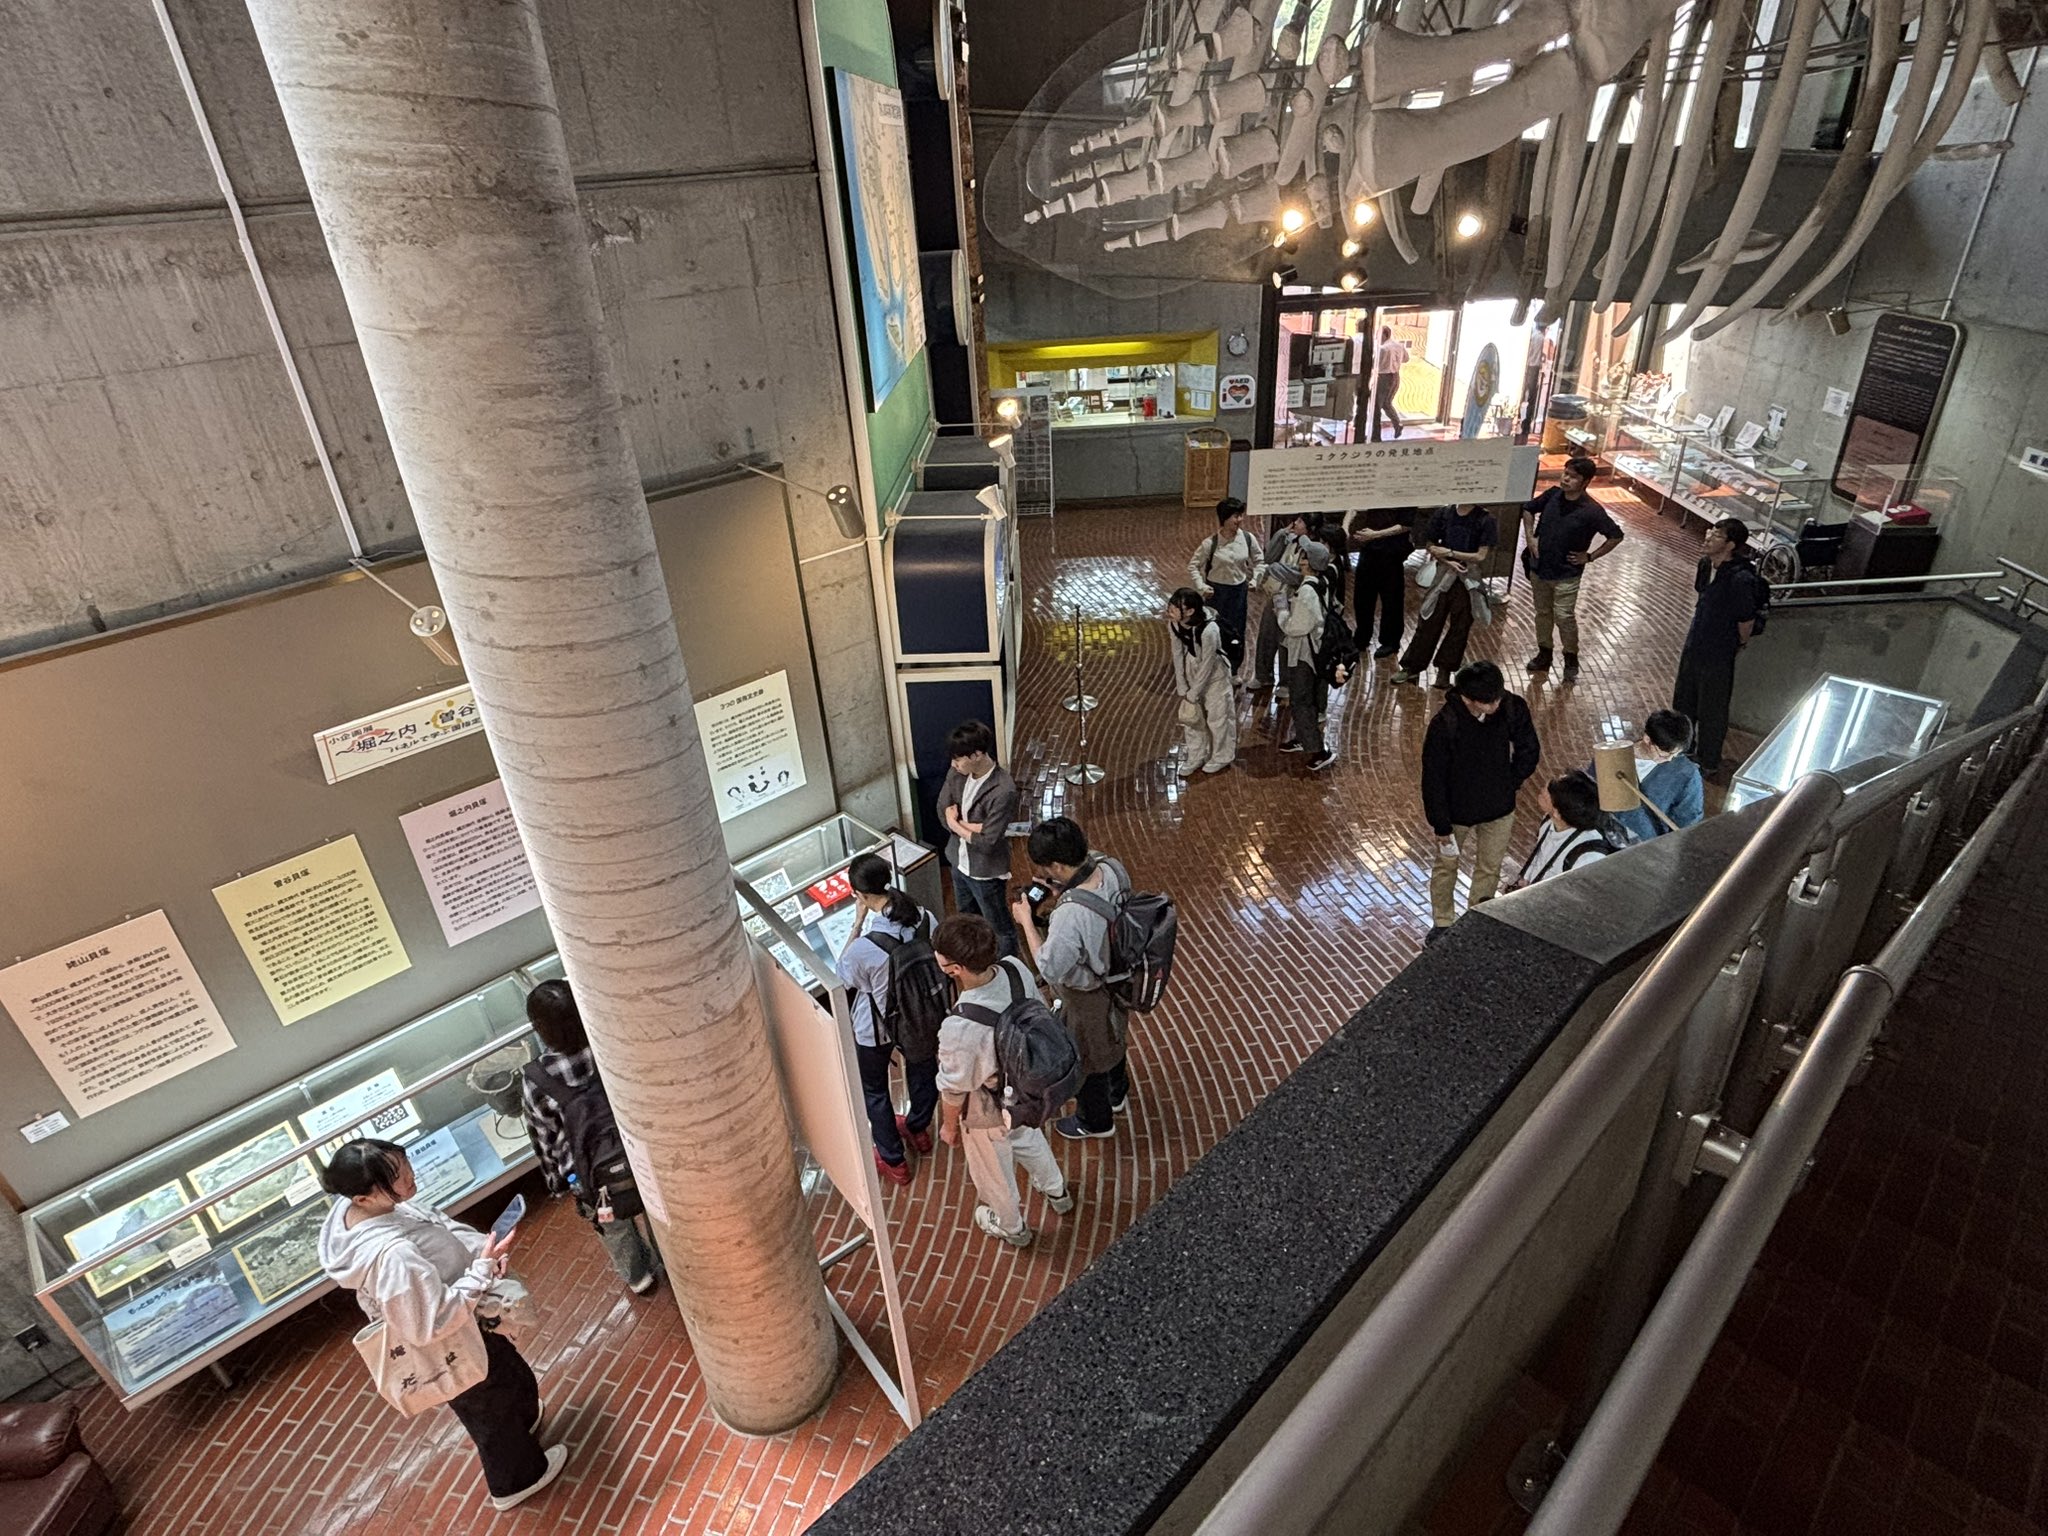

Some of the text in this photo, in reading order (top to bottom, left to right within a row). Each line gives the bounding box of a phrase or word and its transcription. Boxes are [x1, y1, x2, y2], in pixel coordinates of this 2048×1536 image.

[1315, 446, 1436, 462] コククジラの発見地点
[328, 725, 374, 745] 小企画展
[447, 797, 488, 819] 堀之内貝塚
[272, 867, 311, 889] 曽谷貝塚
[64, 945, 112, 970] 姥山貝塚
